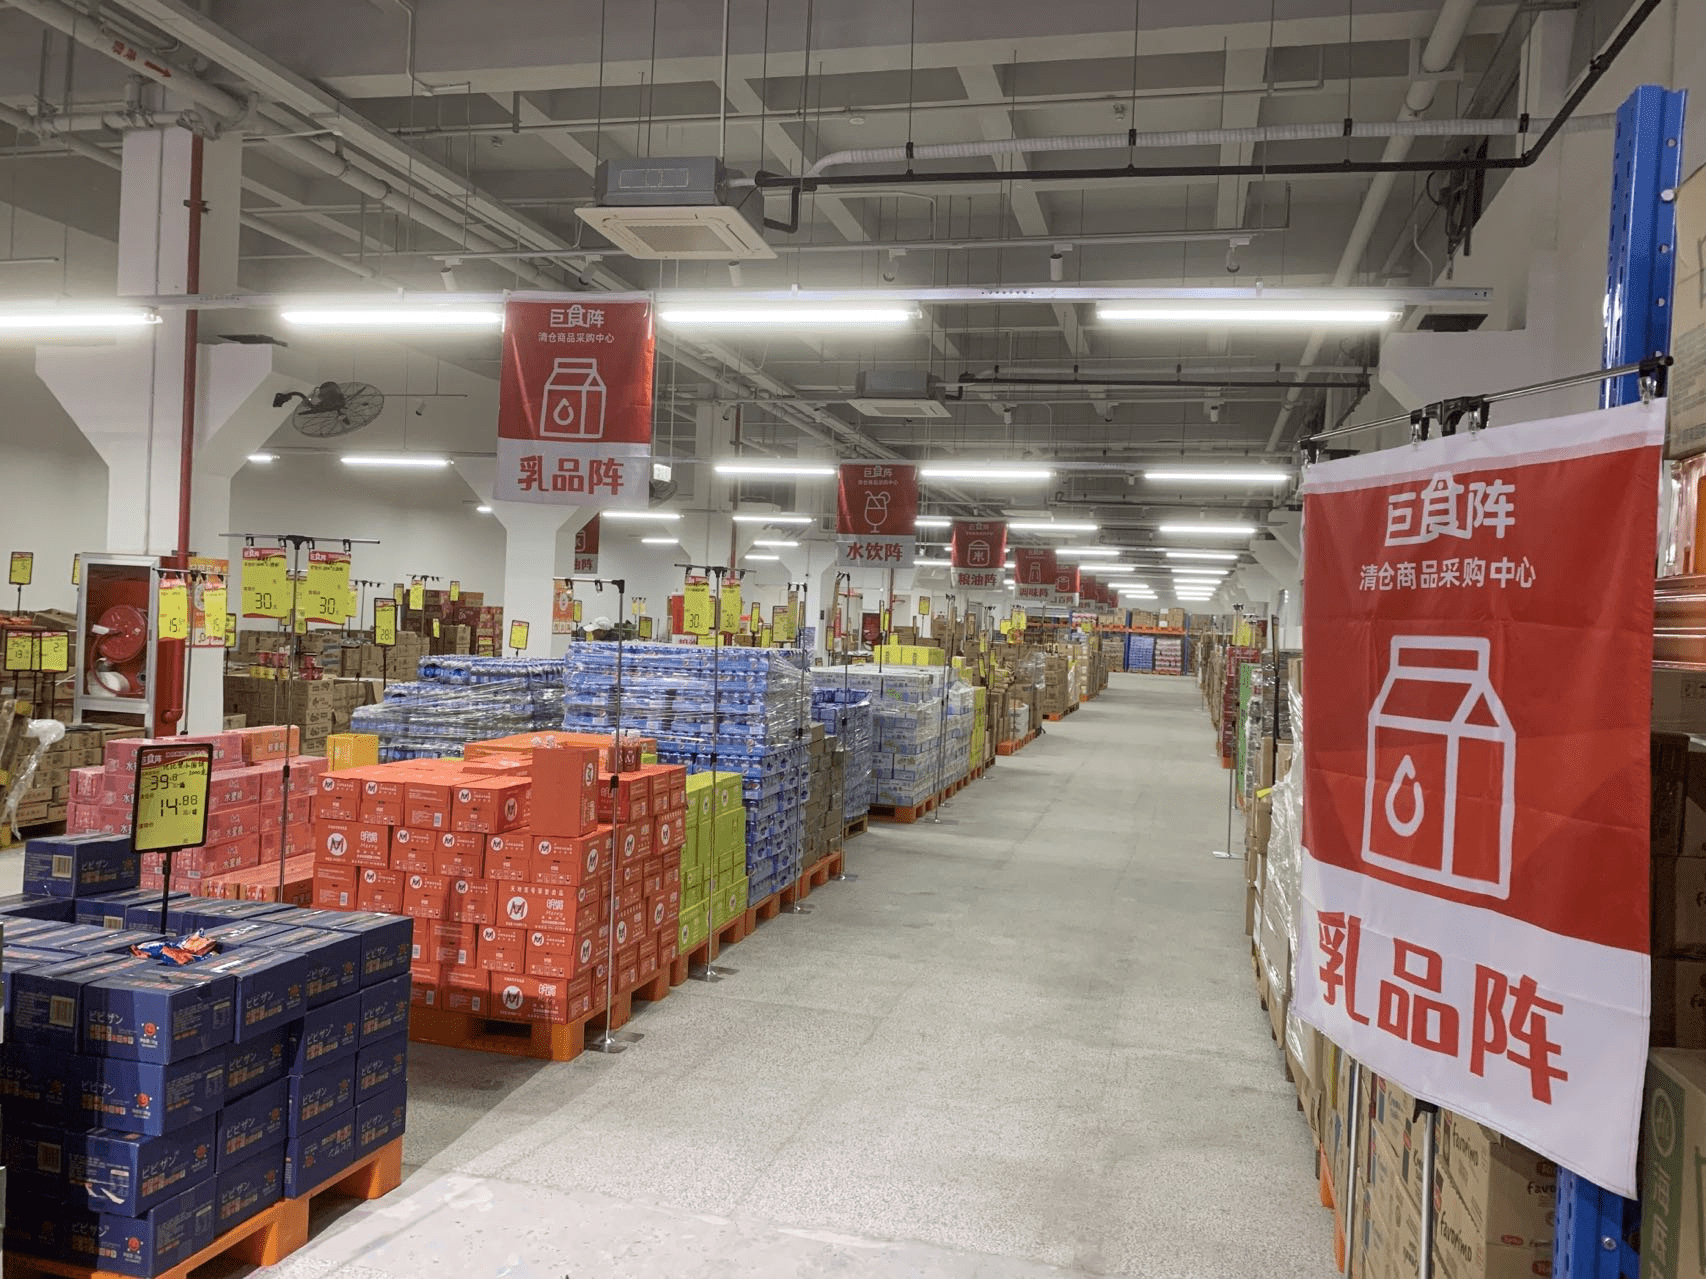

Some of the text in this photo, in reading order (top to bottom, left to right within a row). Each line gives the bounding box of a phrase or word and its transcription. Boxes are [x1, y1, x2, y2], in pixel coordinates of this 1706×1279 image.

[550, 304, 605, 328] 巨食阵
[538, 332, 615, 343] 清仓商品采购中心
[517, 455, 624, 495] 乳品阵
[1384, 471, 1516, 546] 巨食阵
[846, 541, 903, 561] 水饮阵
[1359, 556, 1536, 592] 清仓商品采购中心
[255, 593, 272, 609] 30
[320, 597, 336, 615] 30
[160, 795, 198, 816] 14.88
[1317, 910, 1568, 1105] 乳品阵
